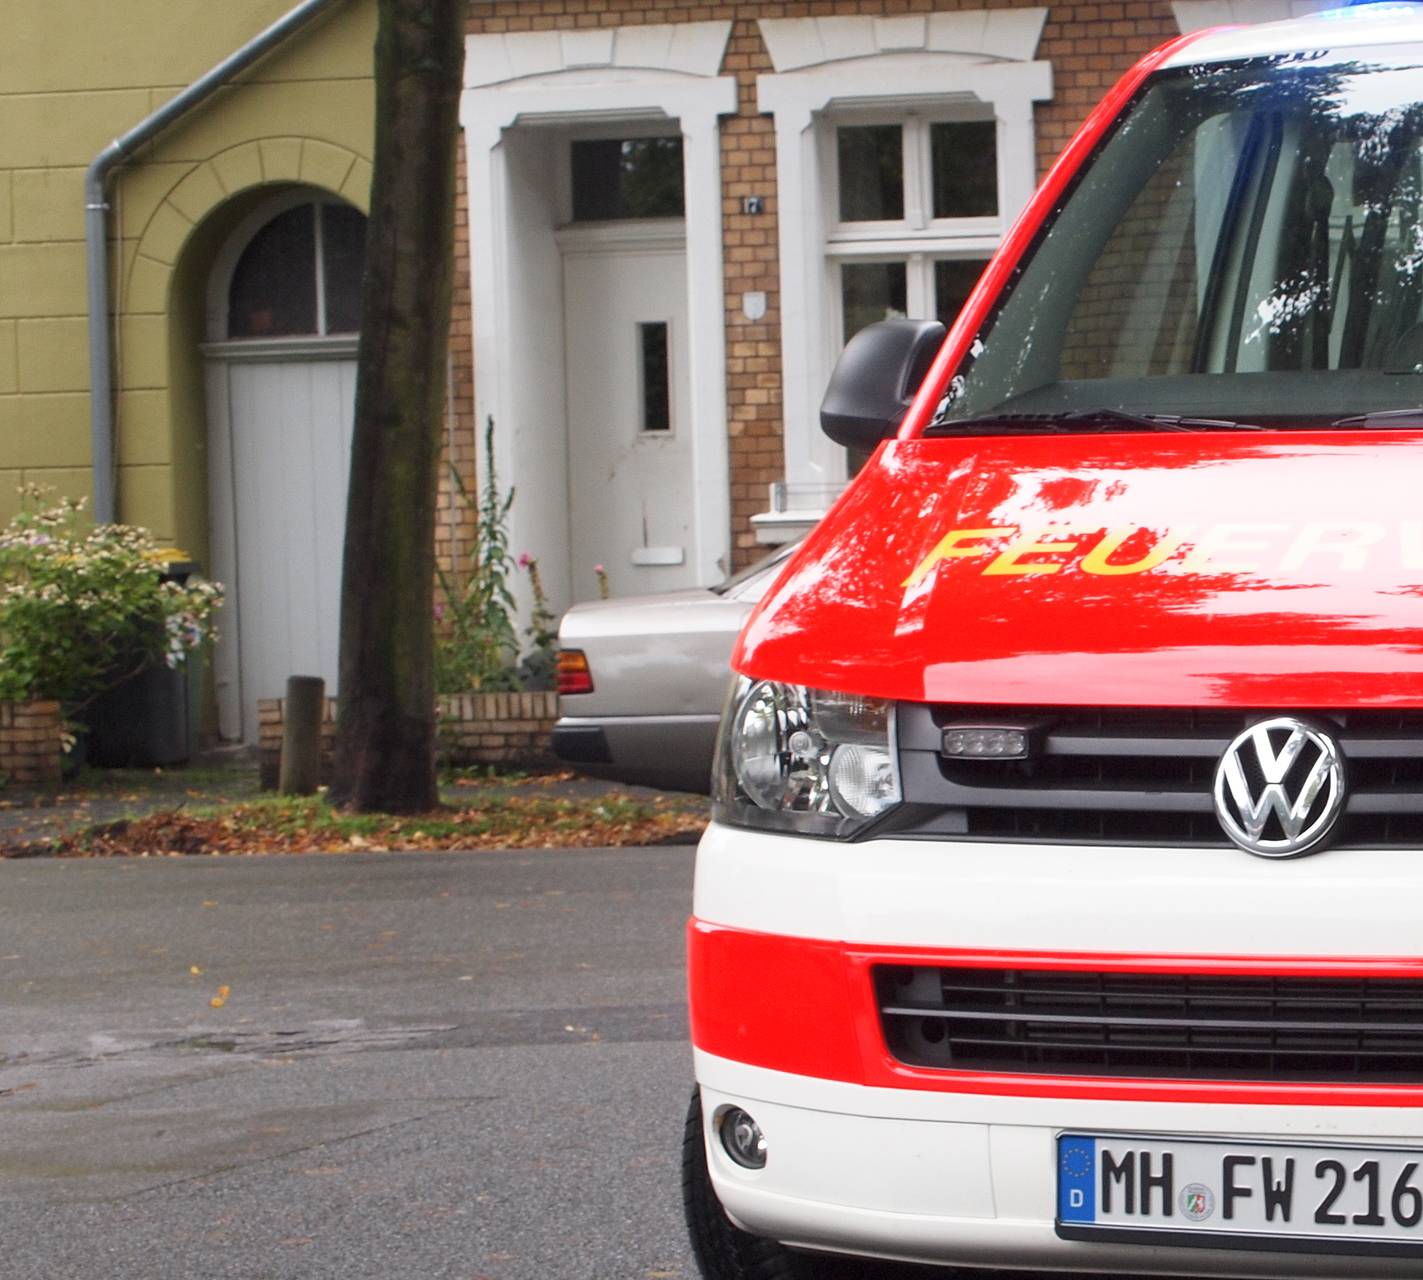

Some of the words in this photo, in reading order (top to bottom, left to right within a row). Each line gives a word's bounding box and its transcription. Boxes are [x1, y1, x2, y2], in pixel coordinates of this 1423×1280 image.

[1069, 1189, 1084, 1208] D
[1101, 1149, 1174, 1216] MH
[1222, 1154, 1295, 1222] FW
